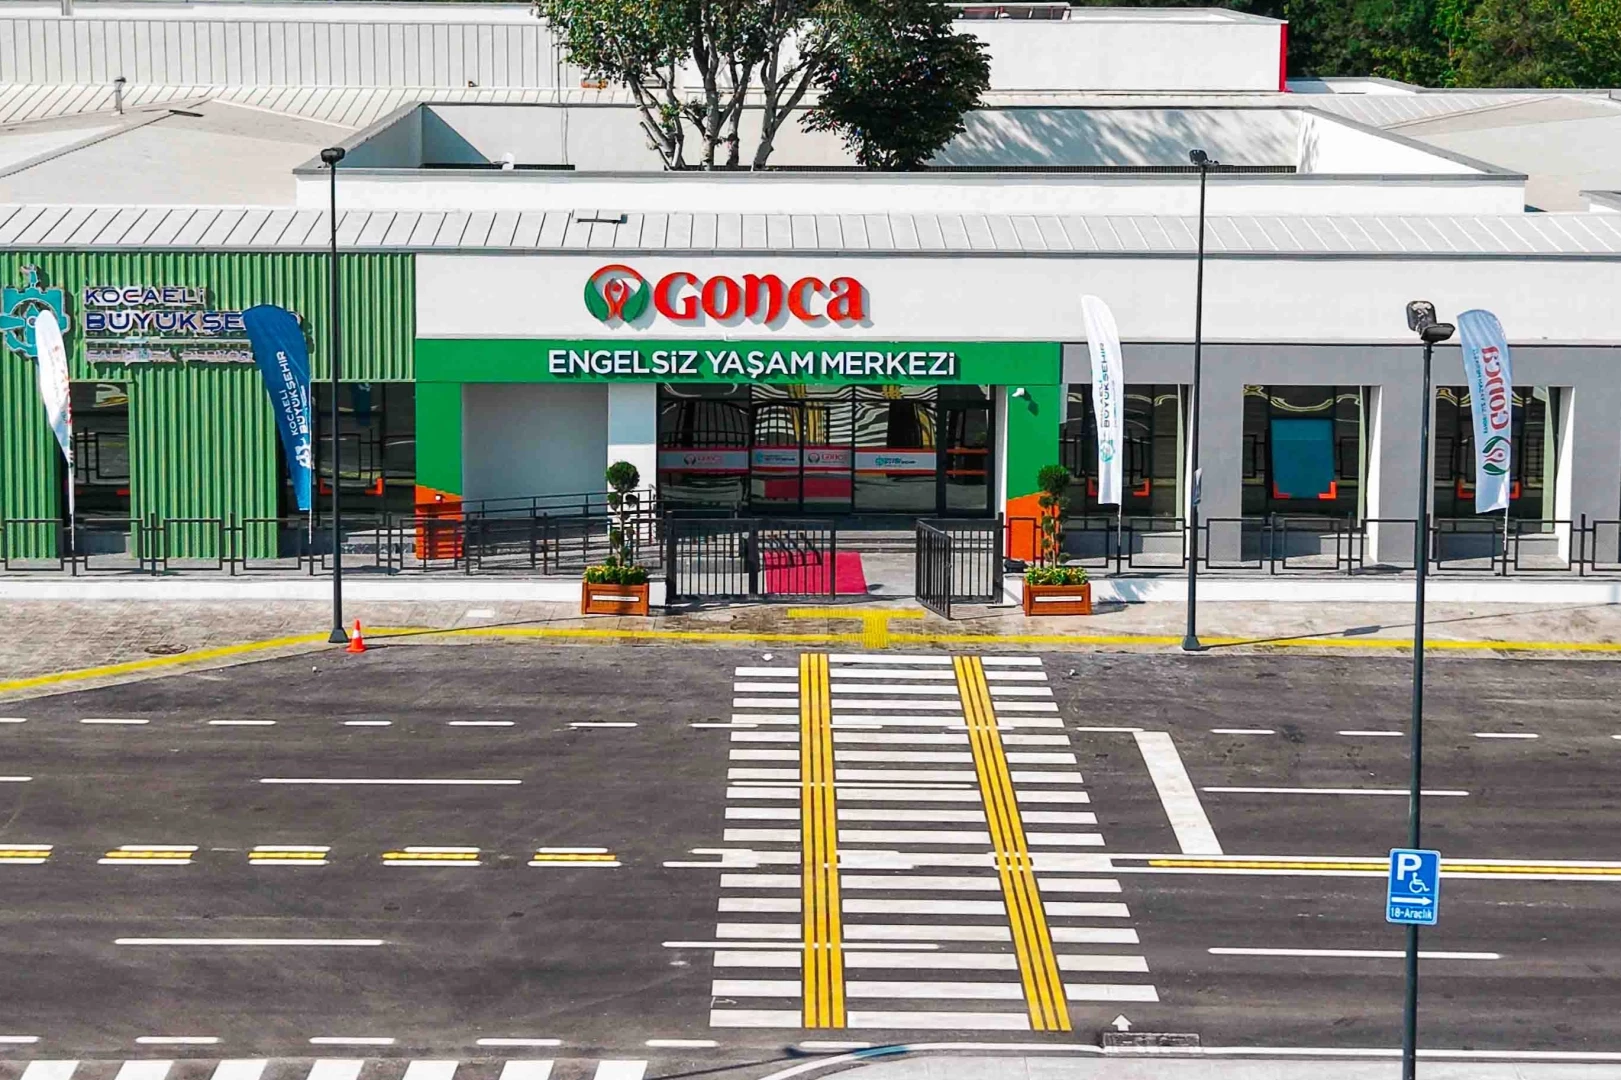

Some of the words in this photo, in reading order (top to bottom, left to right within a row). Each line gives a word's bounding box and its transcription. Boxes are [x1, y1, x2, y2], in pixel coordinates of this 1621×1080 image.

[653, 271, 865, 325] Gonca
[548, 349, 698, 375] ENGELSİZ
[705, 350, 814, 379] YAŞAM
[821, 351, 955, 376] MERKEZİ
[1397, 854, 1422, 880] P
